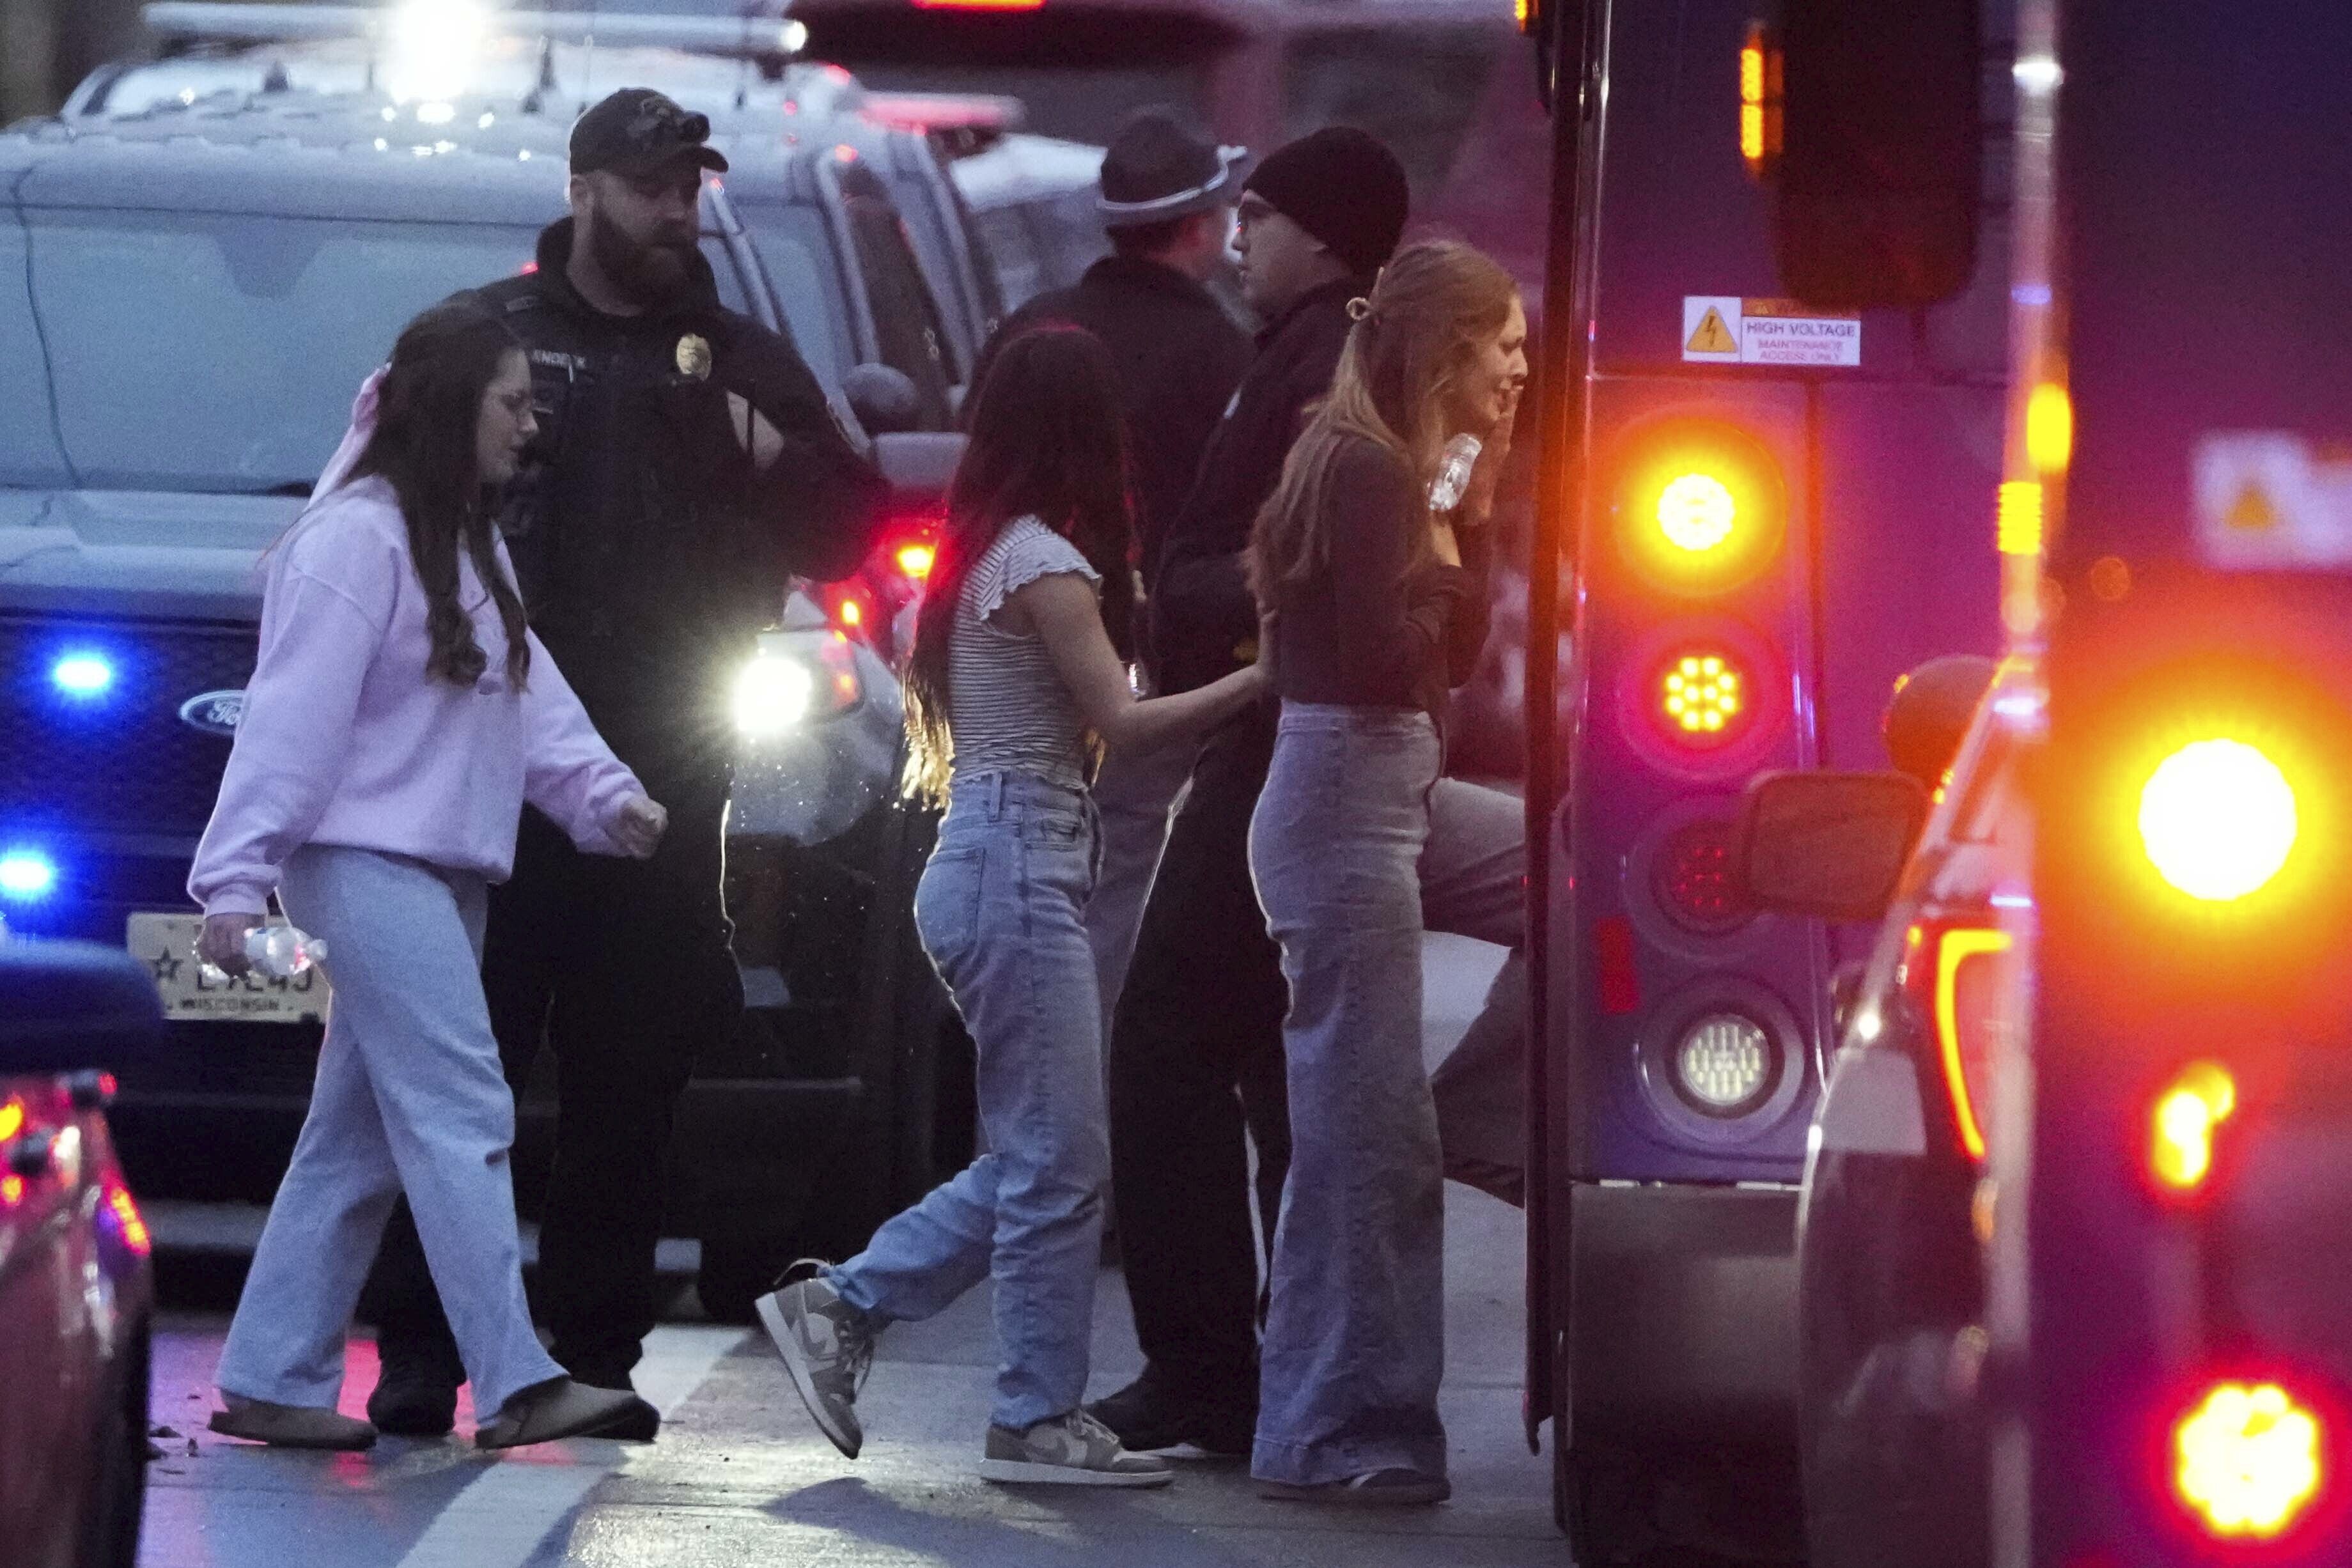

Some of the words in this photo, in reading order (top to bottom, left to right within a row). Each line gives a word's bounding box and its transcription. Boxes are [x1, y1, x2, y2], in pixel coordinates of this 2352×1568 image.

[1747, 322, 1784, 334] HIGH
[1790, 323, 1855, 337] VOLTAGE
[1759, 339, 1843, 350] MAINTENANCE
[1759, 351, 1807, 361] ACCESS
[181, 998, 279, 1011] WISCONSIN
